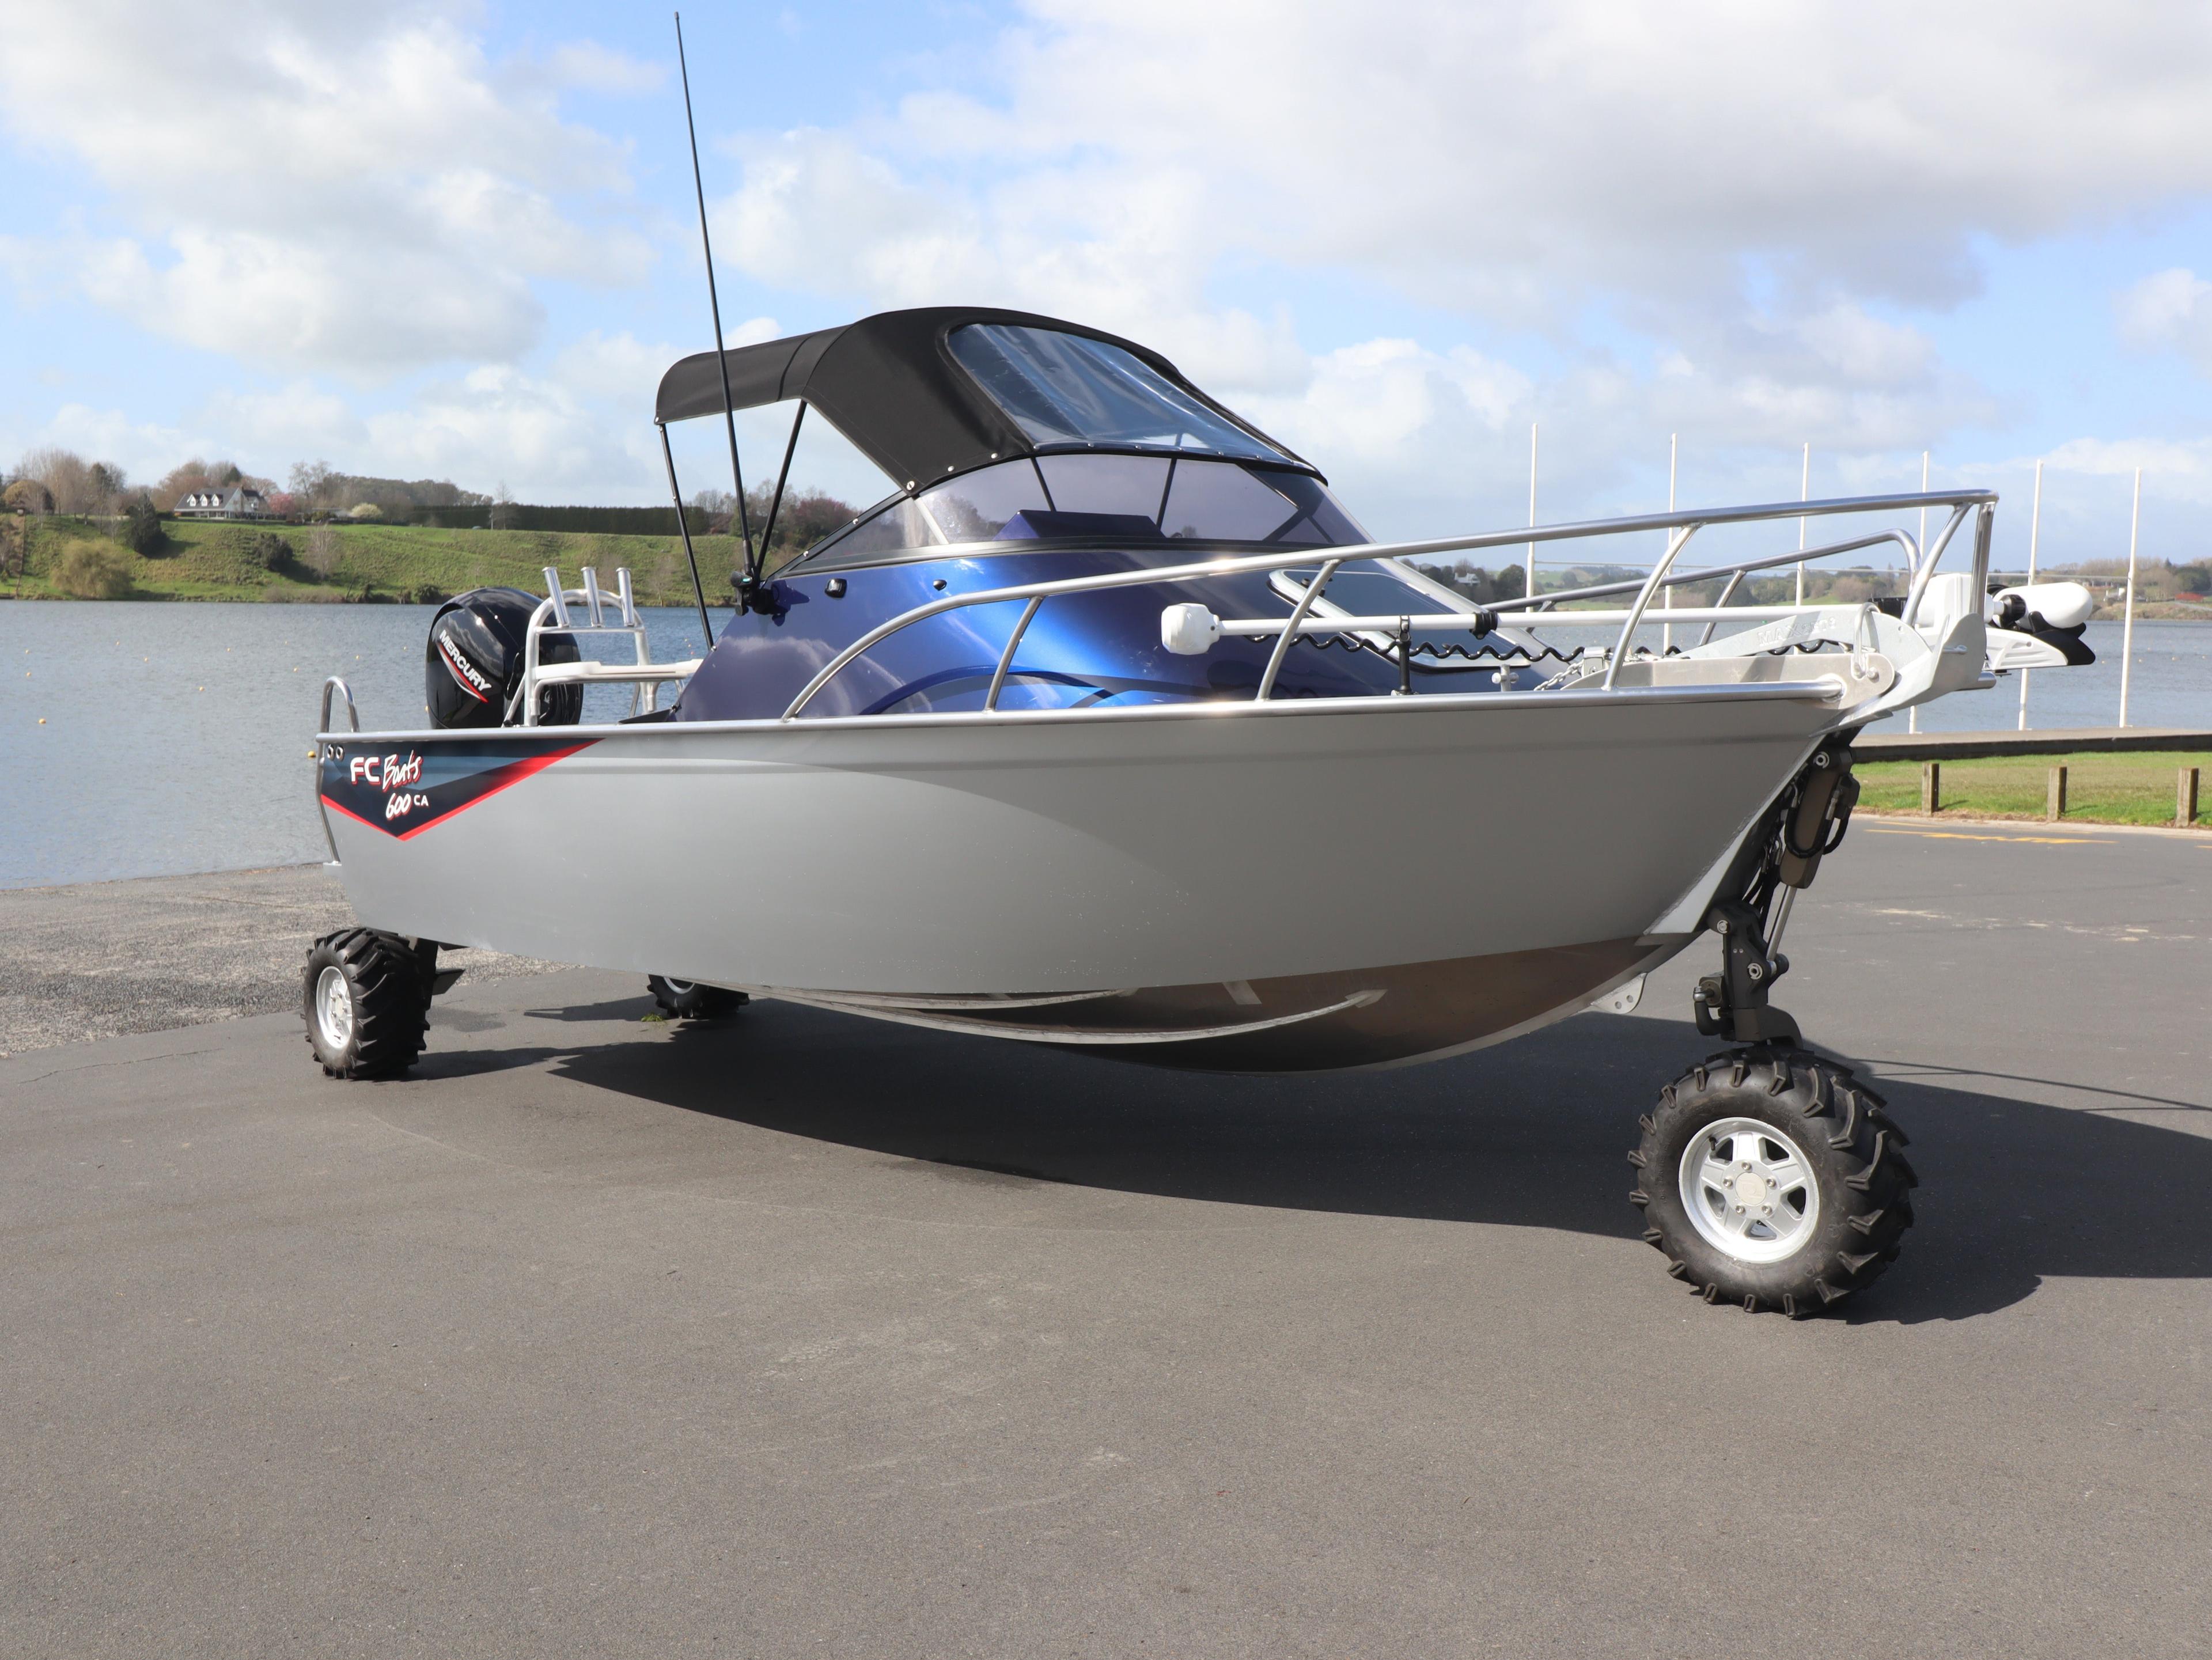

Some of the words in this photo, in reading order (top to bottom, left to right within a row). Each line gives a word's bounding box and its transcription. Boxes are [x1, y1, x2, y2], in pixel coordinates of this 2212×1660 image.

[440, 630, 492, 691] MERCURY
[350, 756, 380, 784] FC
[382, 749, 423, 793] Boats
[385, 793, 412, 820] 600
[414, 795, 429, 806] CA
